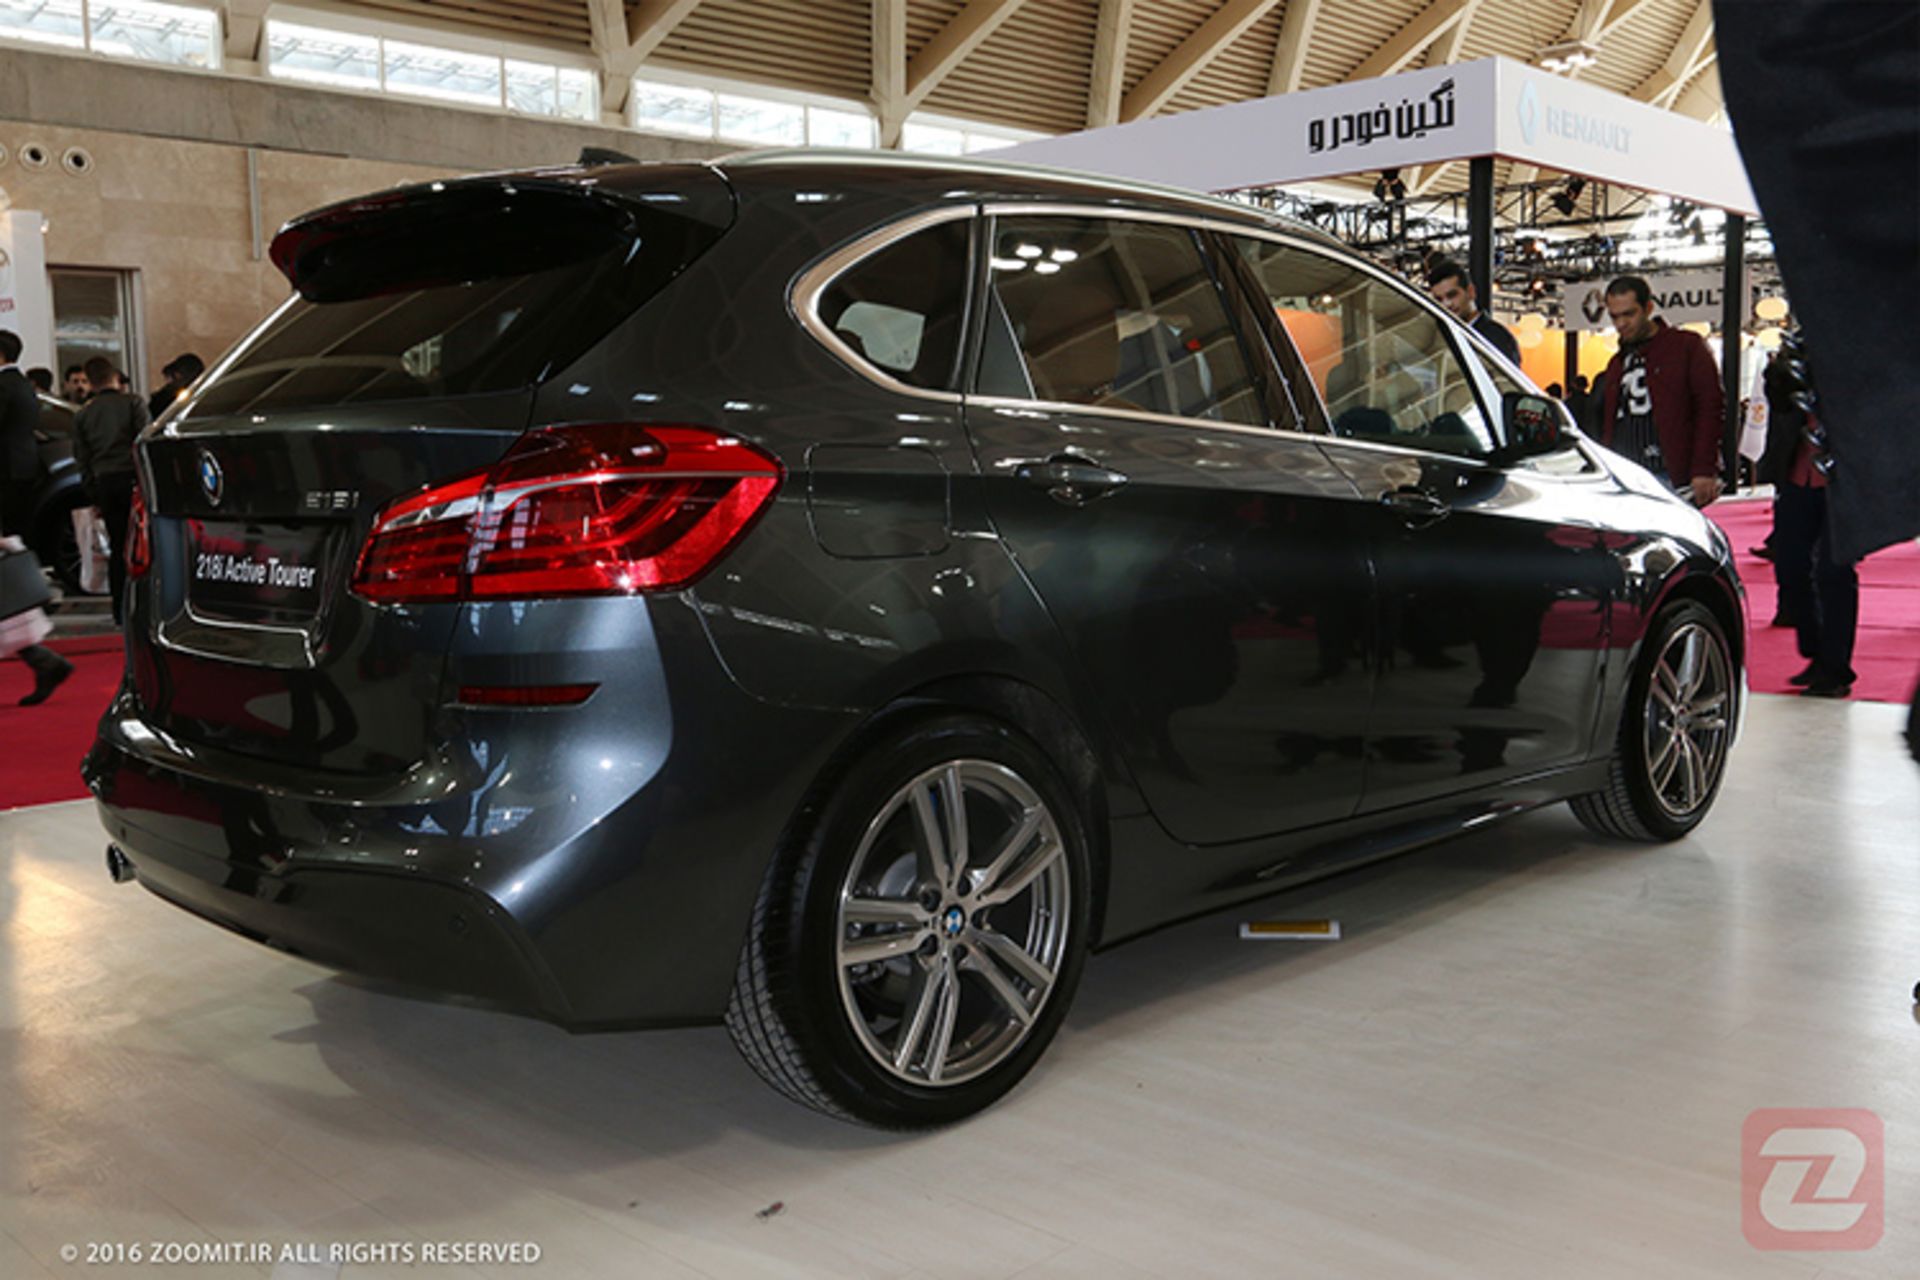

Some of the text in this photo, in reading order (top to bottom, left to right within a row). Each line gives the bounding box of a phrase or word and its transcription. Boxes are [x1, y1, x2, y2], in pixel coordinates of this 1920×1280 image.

[1546, 105, 1634, 155] RENAULT
[1651, 287, 1724, 309] NAUL
[196, 553, 316, 588] 218i Active Tourer
